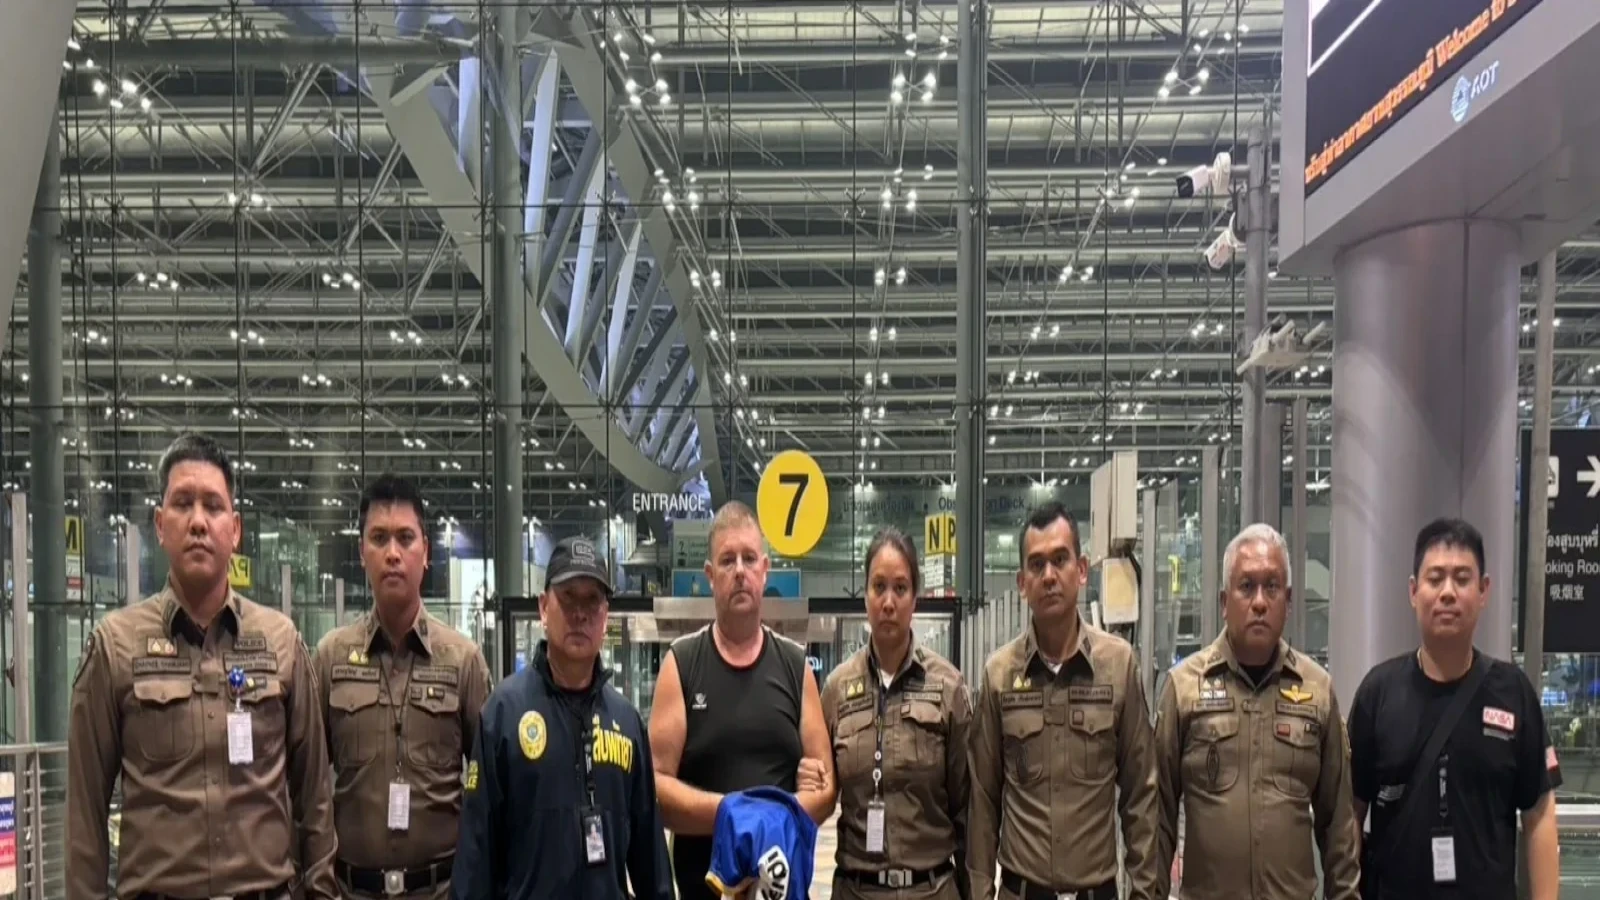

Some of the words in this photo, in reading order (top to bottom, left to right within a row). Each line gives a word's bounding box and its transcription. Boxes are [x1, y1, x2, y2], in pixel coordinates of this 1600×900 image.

[1436, 8, 1490, 68] Welcome
[1470, 60, 1499, 99] AOT
[632, 492, 706, 512] ENTRANCE
[779, 473, 809, 536] 7
[929, 517, 940, 551] N
[1545, 558, 1574, 579] oking
[1577, 558, 1600, 576] Roo
[1485, 709, 1512, 726] NASA
